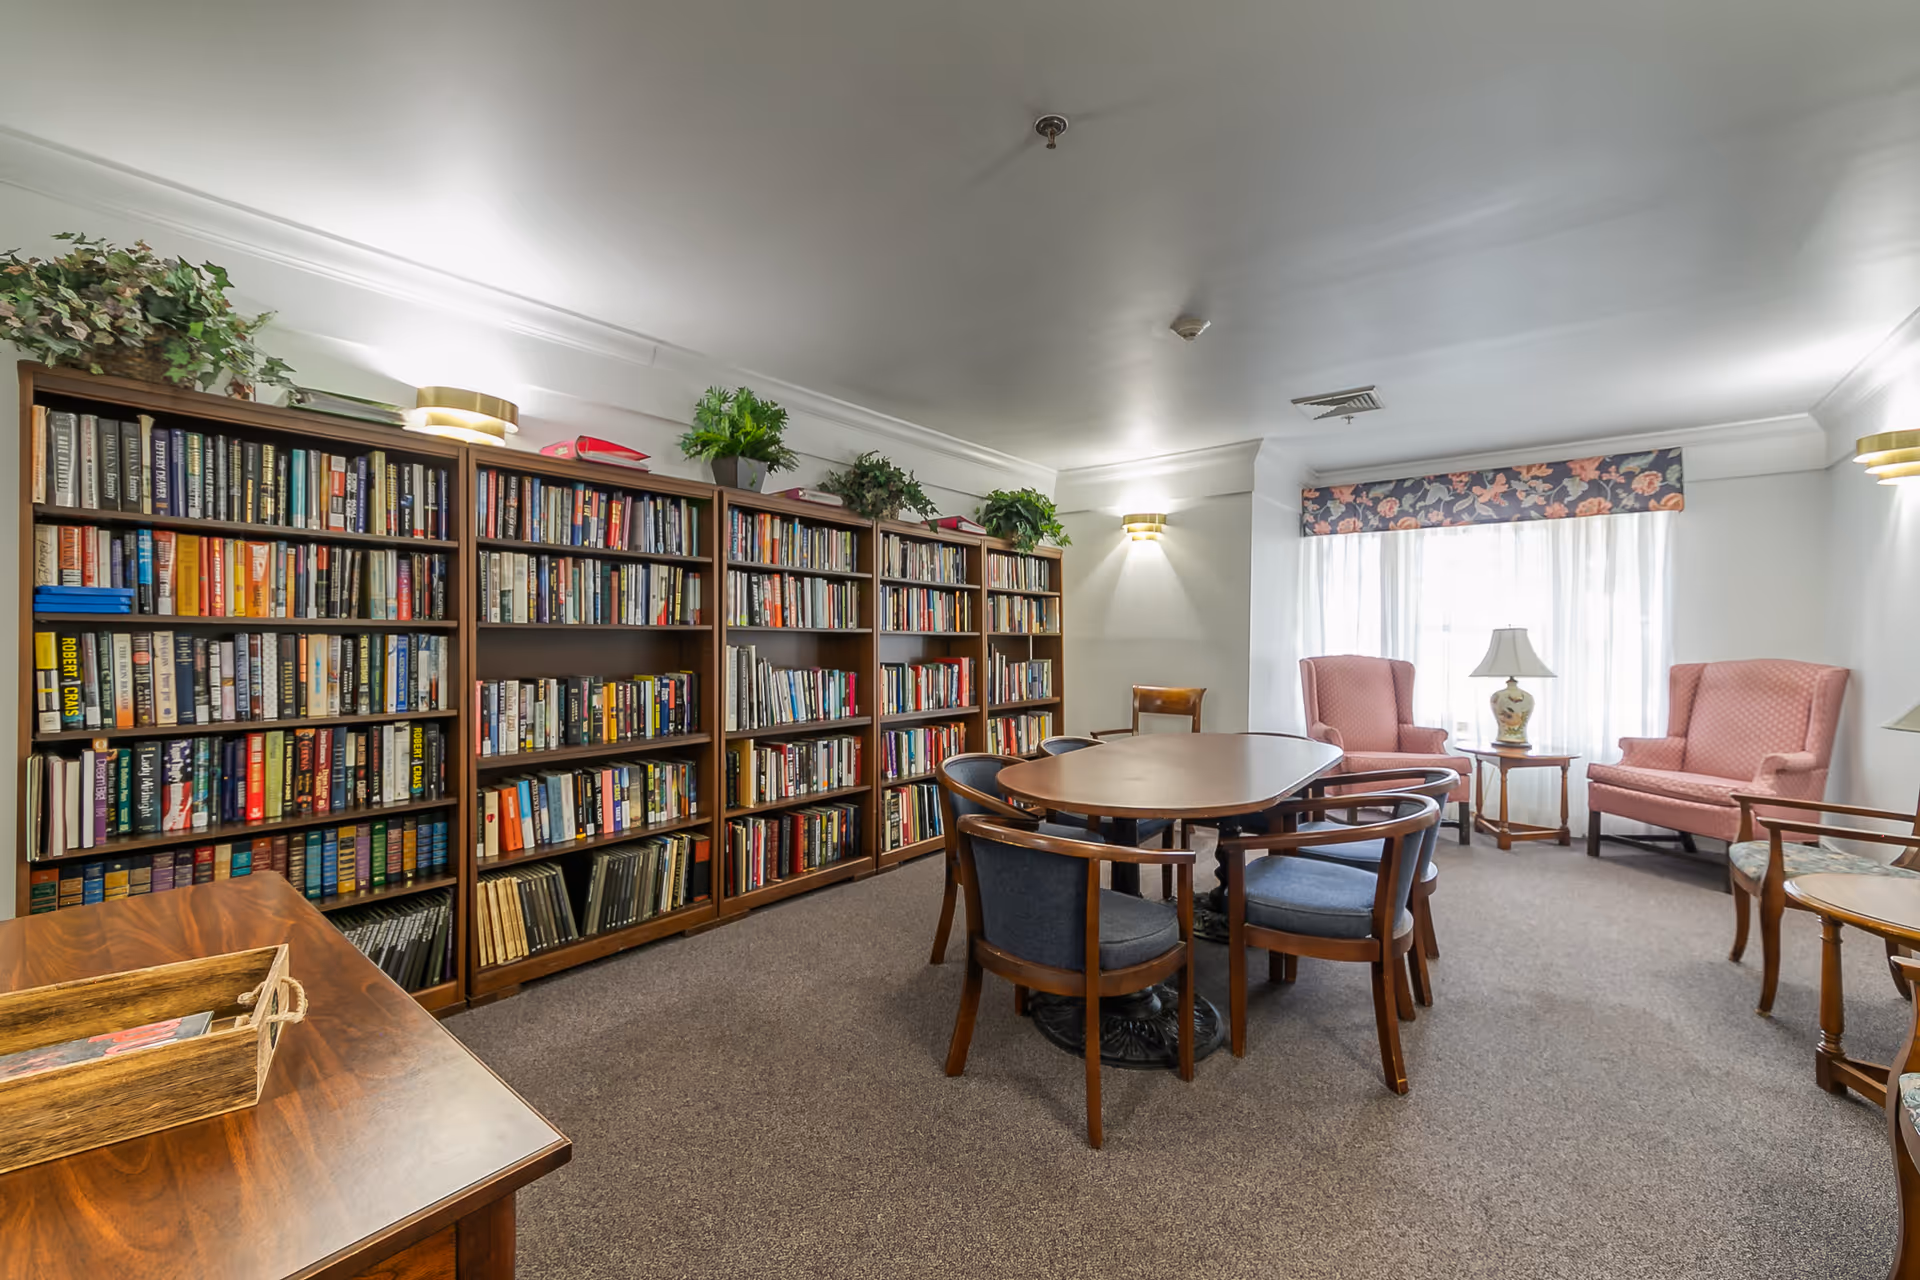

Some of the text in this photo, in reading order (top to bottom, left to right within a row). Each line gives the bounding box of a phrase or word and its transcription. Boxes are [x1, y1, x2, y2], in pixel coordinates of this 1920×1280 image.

[104, 434, 117, 500] DRIVEN Eternity
[127, 438, 140, 503] DRIVEN Eternity
[155, 440, 167, 499] JEFFERY DEAVER
[206, 449, 214, 467] THINK
[206, 469, 214, 484] LIKE
[118, 646, 127, 660] THE
[360, 638, 369, 648] ERIC
[62, 638, 79, 716] ROBERT CRAIS
[120, 680, 129, 711] BRIGADE
[284, 661, 293, 704] STALINGRAD
[95, 759, 107, 801] Dream Big
[120, 757, 129, 802] The Balloon Man
[413, 727, 423, 789] ROBERT CRAIS
[137, 754, 154, 818] Lady Midnight
